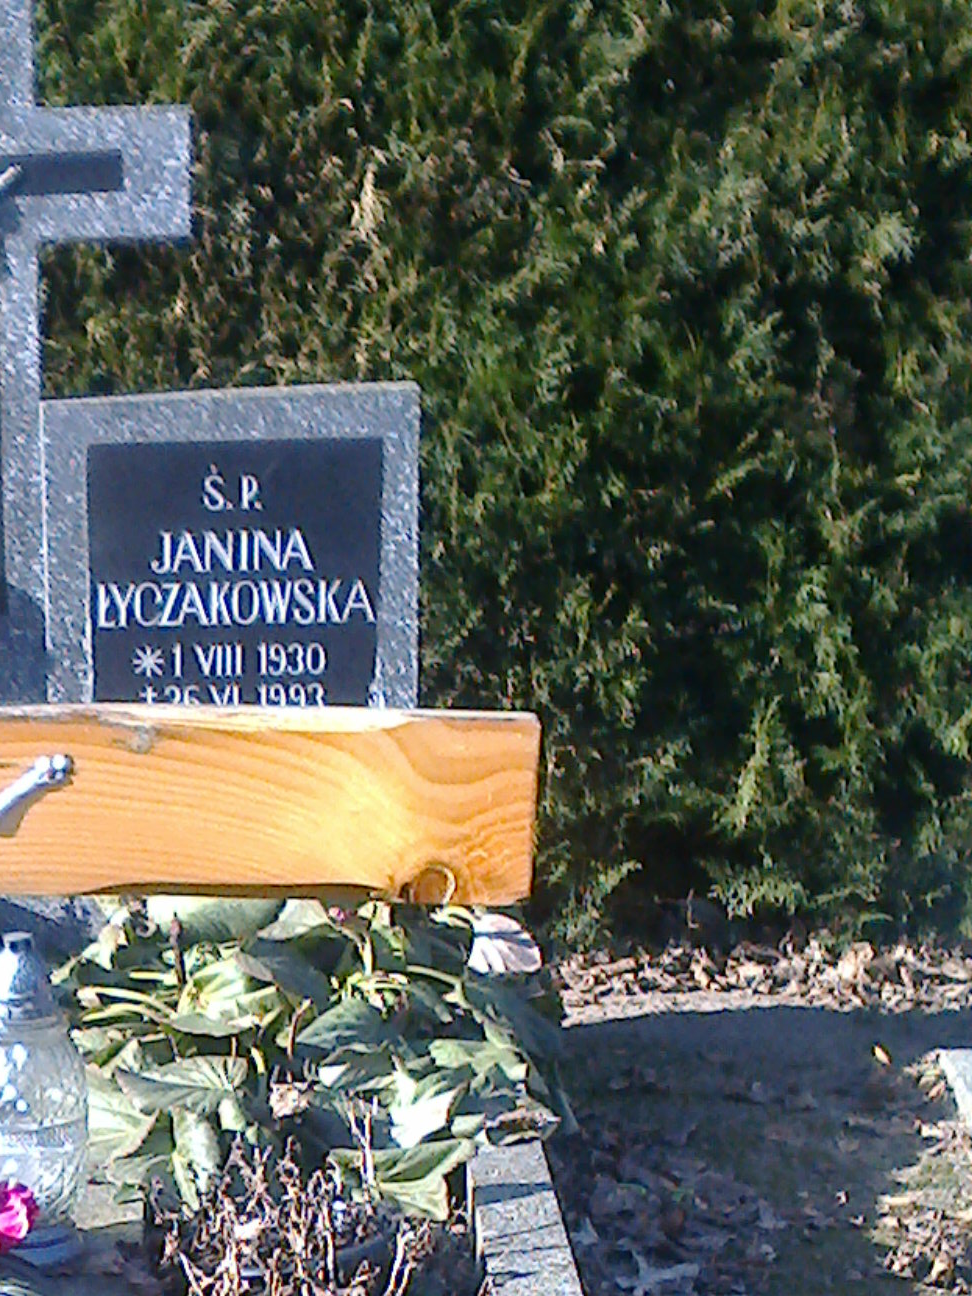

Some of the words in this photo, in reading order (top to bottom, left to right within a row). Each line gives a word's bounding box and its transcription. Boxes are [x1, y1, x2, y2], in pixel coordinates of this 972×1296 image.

[239, 474, 263, 510] P.
[149, 529, 314, 574] JANINA
[96, 579, 376, 629] ŁYCZAKOWSKA
[172, 642, 182, 677] 1
[193, 641, 242, 677] VIII
[257, 641, 326, 676] 1930
